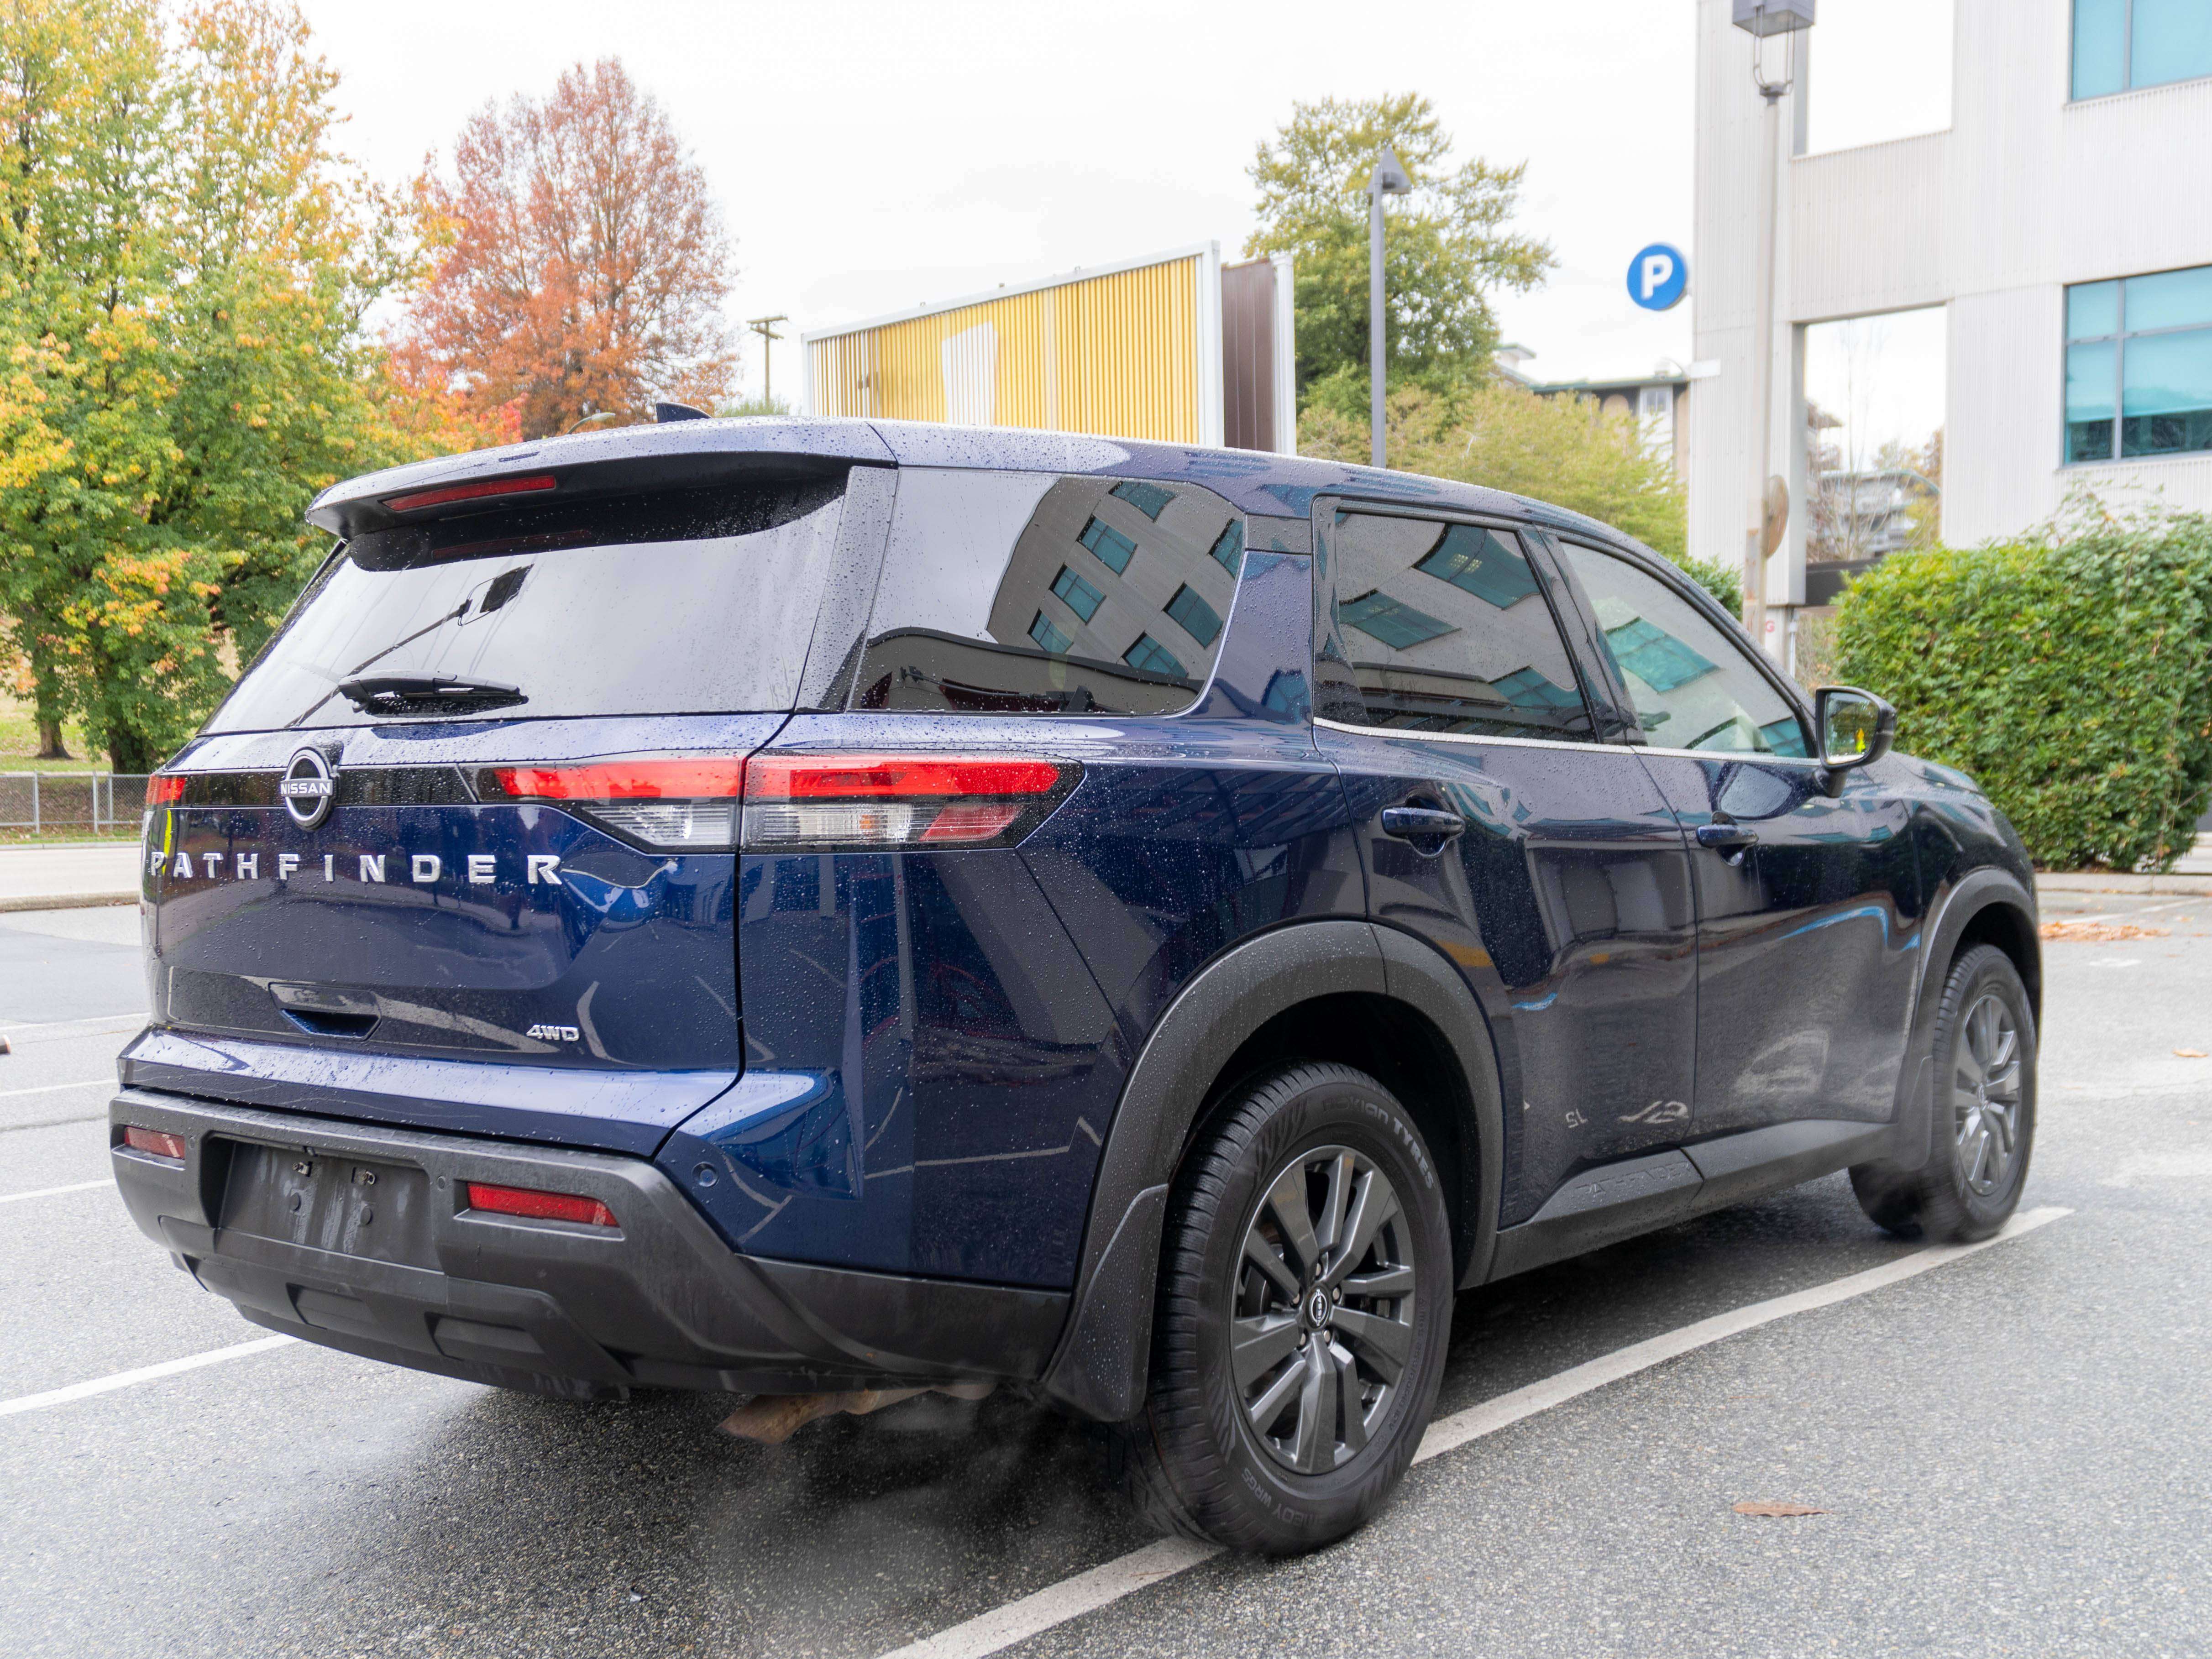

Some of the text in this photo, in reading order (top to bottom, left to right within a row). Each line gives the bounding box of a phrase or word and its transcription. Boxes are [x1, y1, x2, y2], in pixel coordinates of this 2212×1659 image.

[1642, 254, 1673, 301] P
[281, 782, 330, 794] NISSAN
[150, 852, 563, 885] PATHFINDER
[526, 1024, 580, 1041] 4WD
[1394, 1117, 1434, 1189] TYRES
